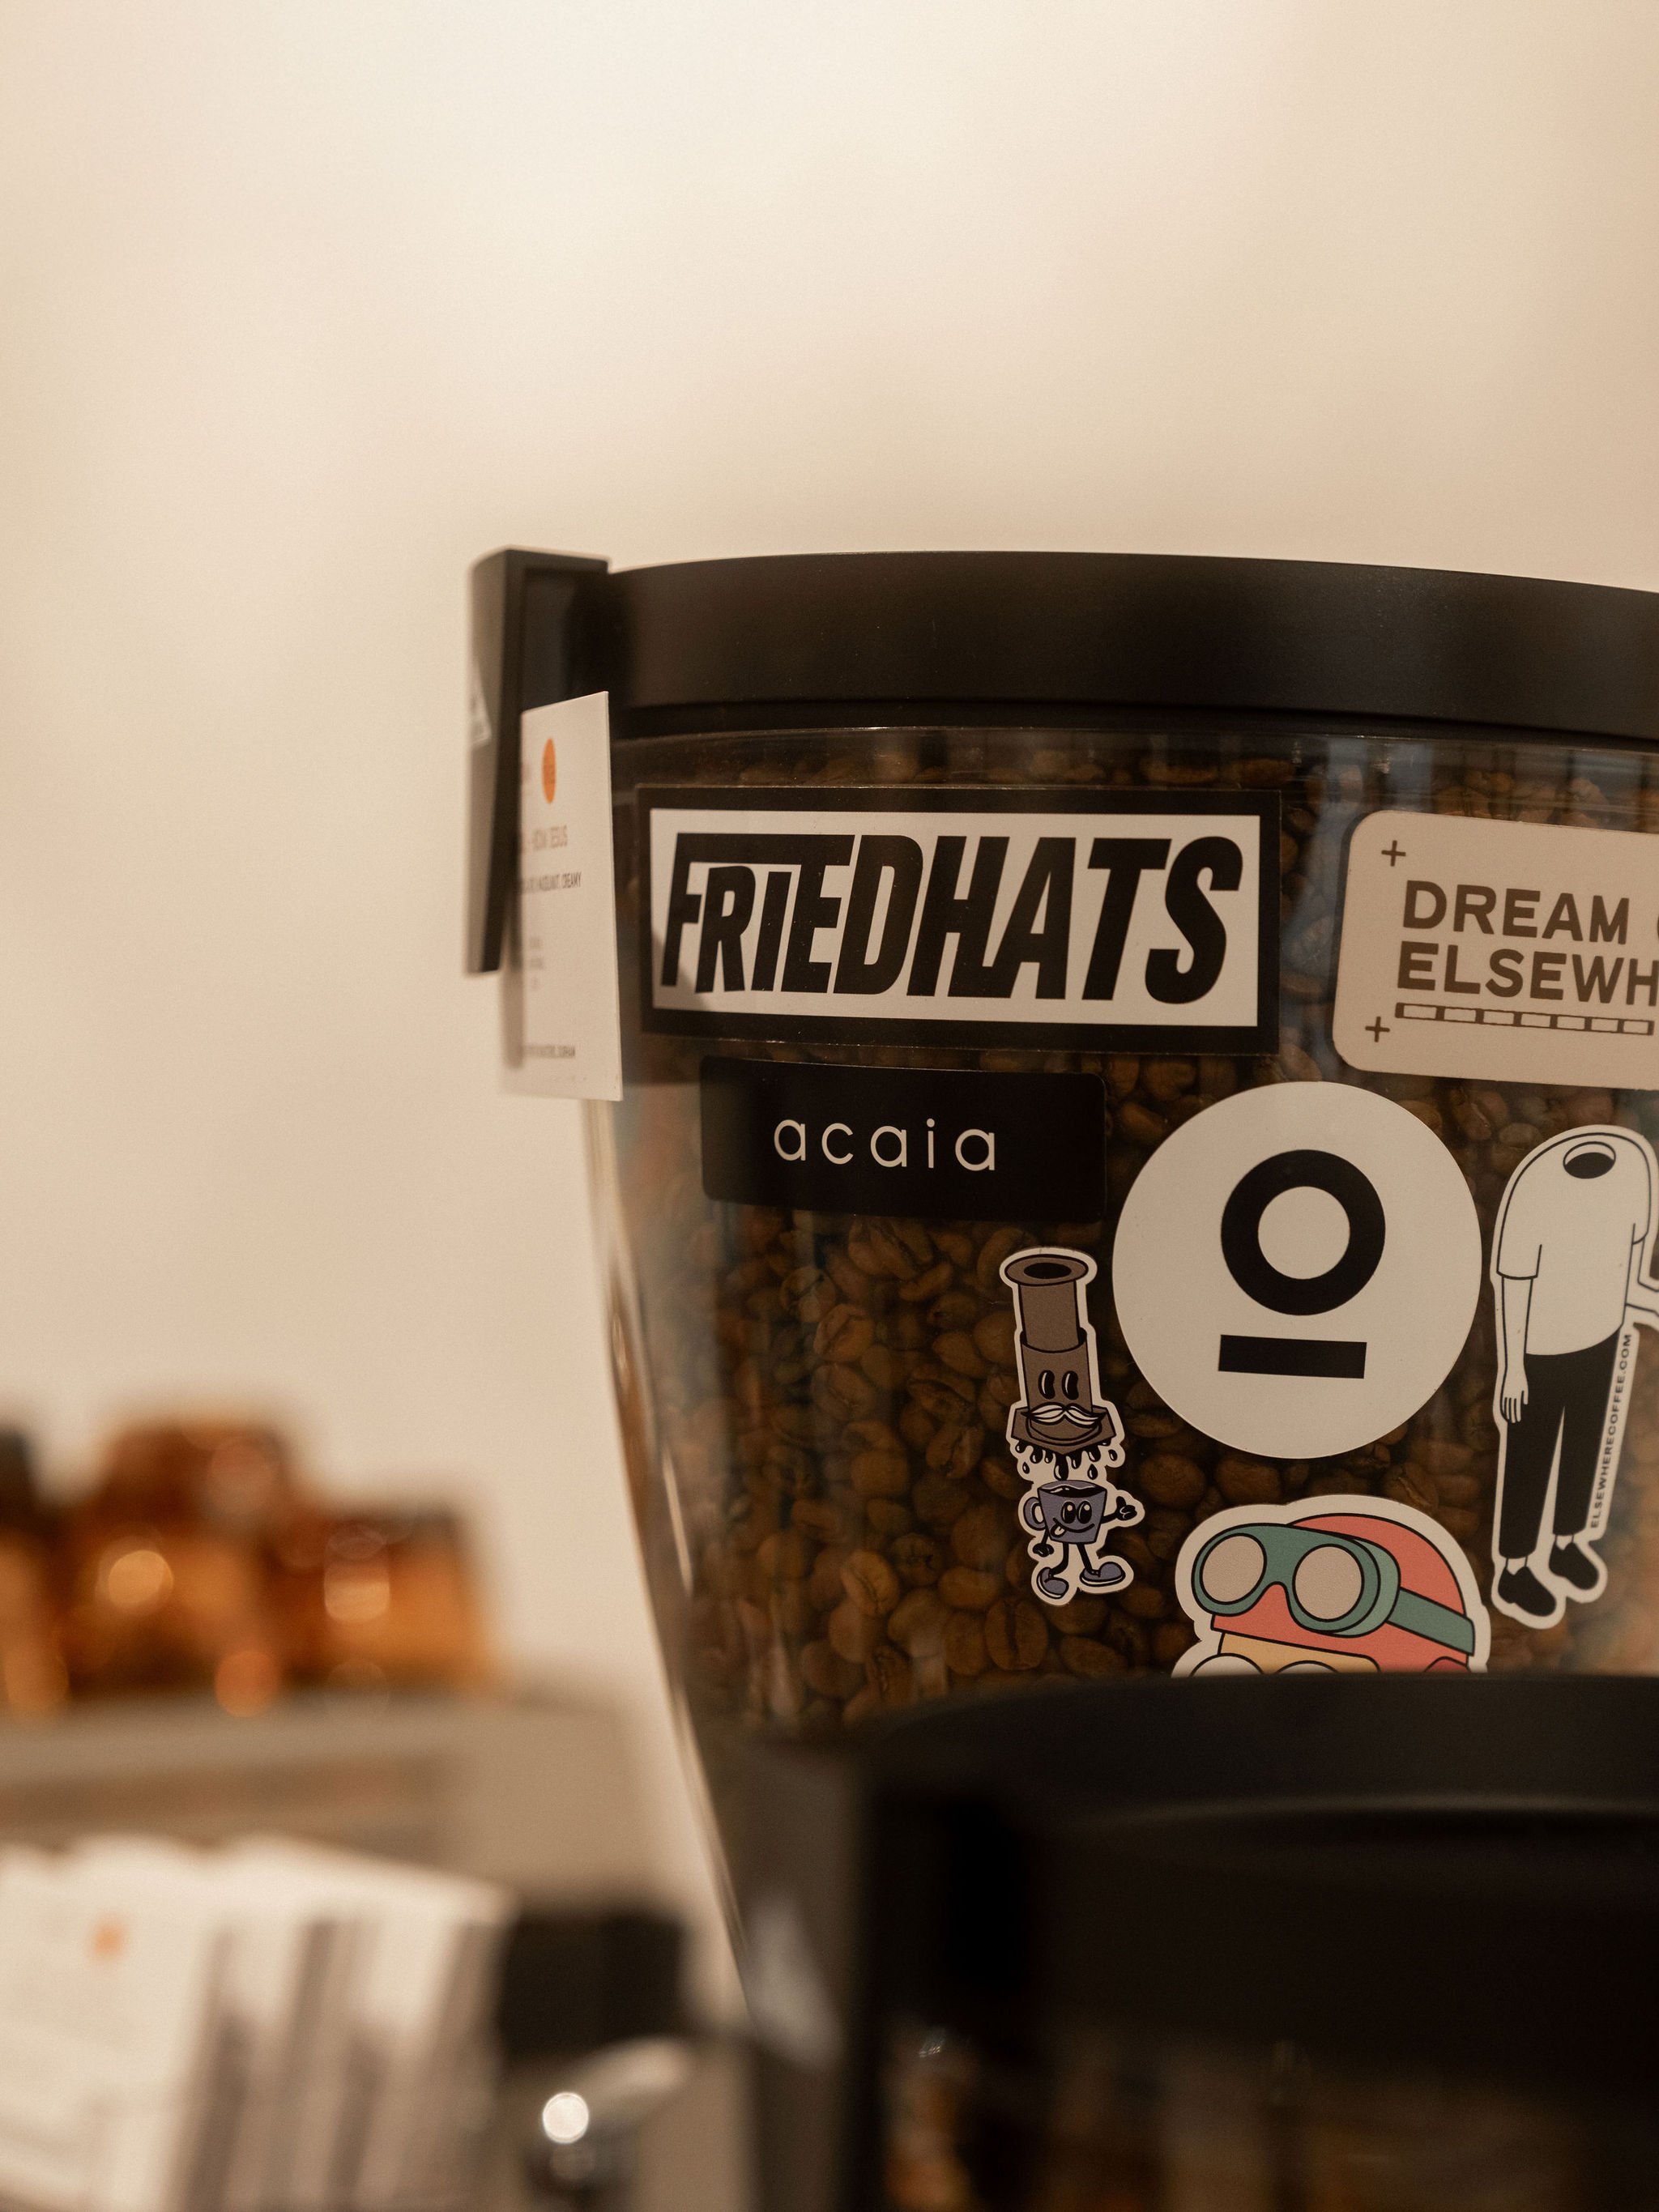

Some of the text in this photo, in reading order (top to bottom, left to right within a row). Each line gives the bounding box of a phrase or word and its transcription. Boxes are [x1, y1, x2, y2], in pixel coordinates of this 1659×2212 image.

[660, 832, 1243, 1004] FRIEDHATS
[1402, 879, 1630, 945] DREAM
[1397, 940, 1659, 1007] ELSEWH
[773, 1118, 996, 1172] acaia
[1590, 1333, 1632, 1529] ELSEWHERECOFFEE.COM
